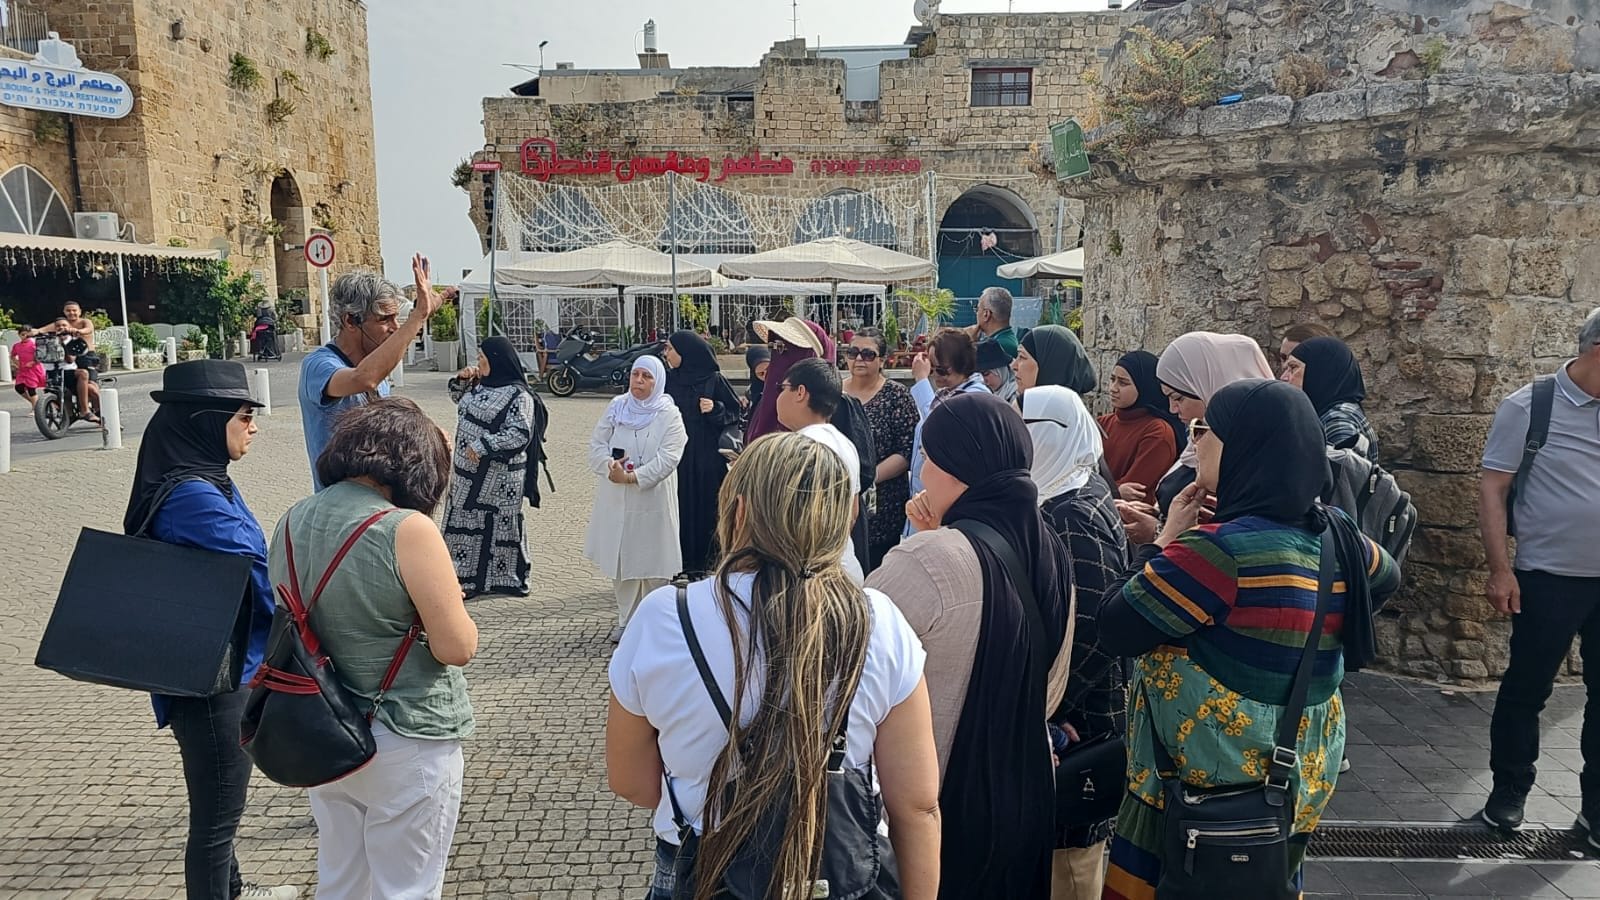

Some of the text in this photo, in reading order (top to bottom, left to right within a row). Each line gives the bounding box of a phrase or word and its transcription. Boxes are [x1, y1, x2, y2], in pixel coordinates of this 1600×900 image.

[0, 66, 123, 93] مطعم البرج و البح
[0, 82, 33, 93] LBOURG
[43, 88, 57, 96] THE
[59, 90, 74, 99] SEA
[76, 92, 122, 105] RESTAURANT
[3, 92, 28, 102] והים
[79, 102, 115, 114] מסעדת
[714, 147, 794, 183] مطعم
